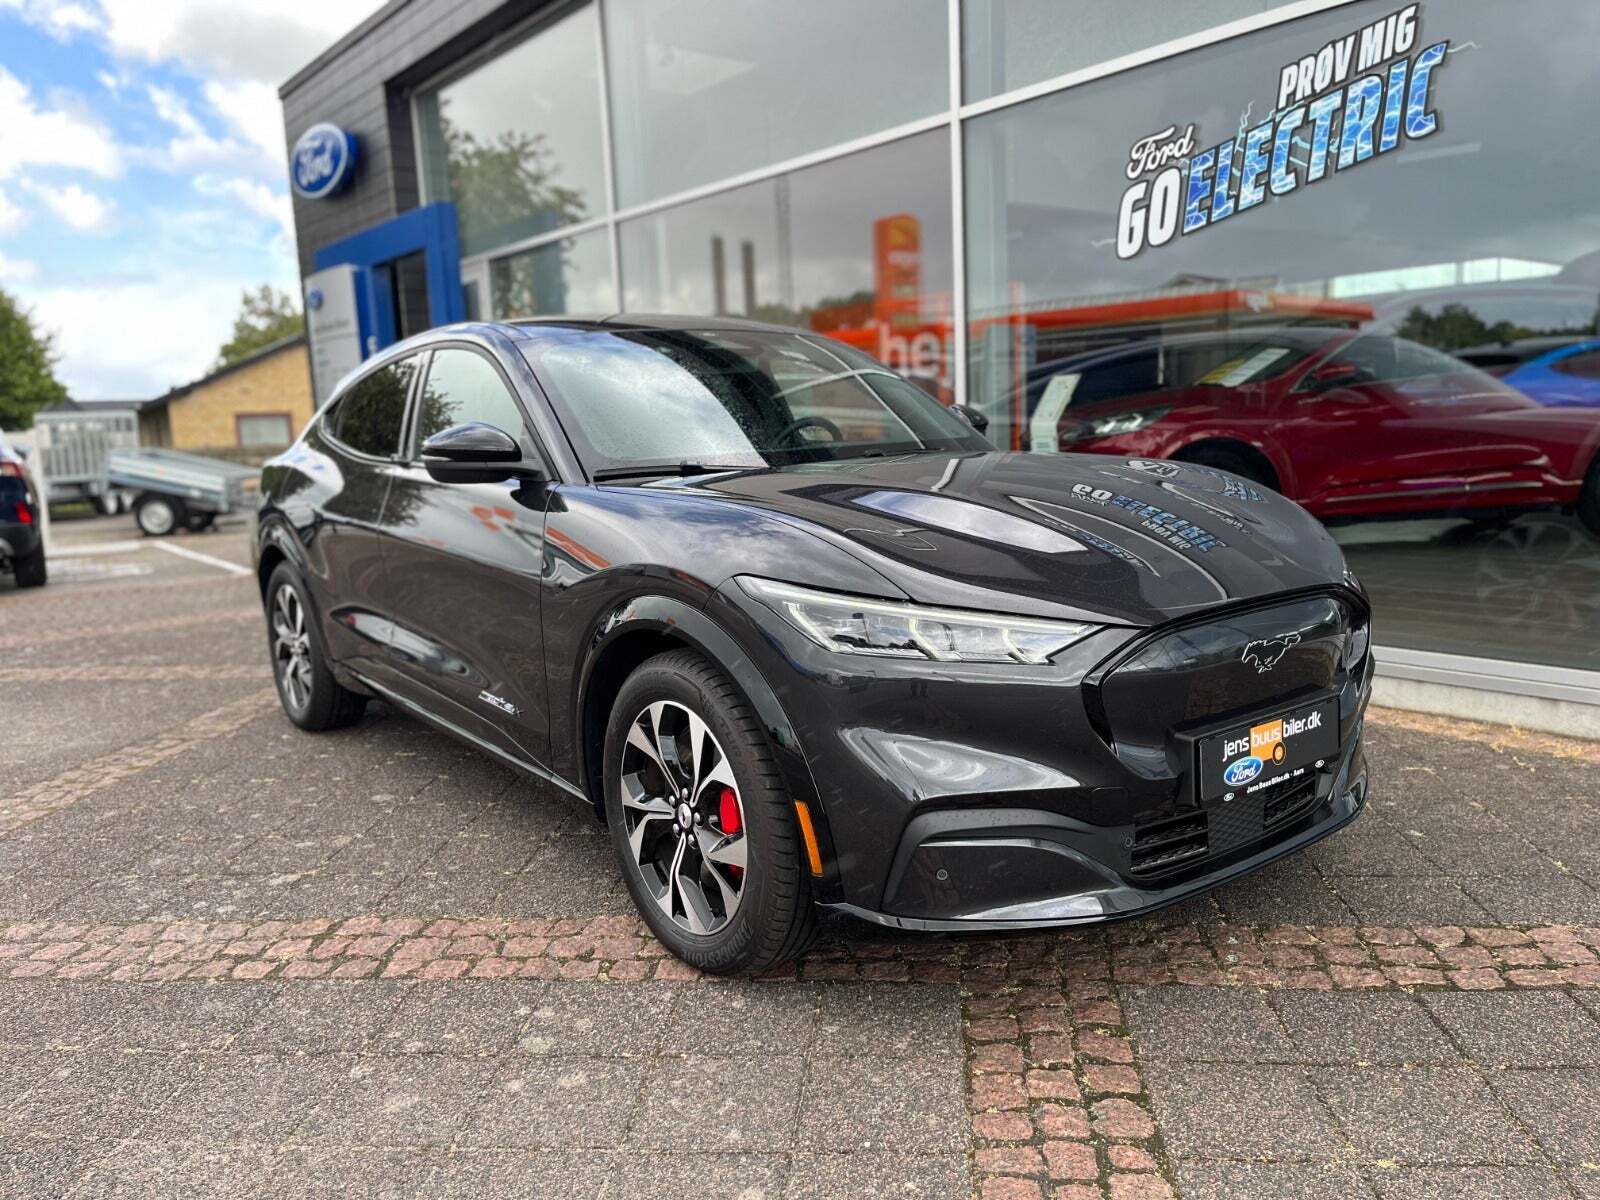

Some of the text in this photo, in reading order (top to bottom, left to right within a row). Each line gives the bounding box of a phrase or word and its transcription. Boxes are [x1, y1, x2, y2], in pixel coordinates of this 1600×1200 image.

[1279, 3, 1419, 109] PRØV MIG
[298, 136, 334, 188] Ford
[1117, 41, 1448, 258] GO ELECTRIC
[1128, 125, 1194, 179] Ford
[1223, 712, 1321, 761] jens buus biler.dk
[1231, 760, 1256, 782] Ford
